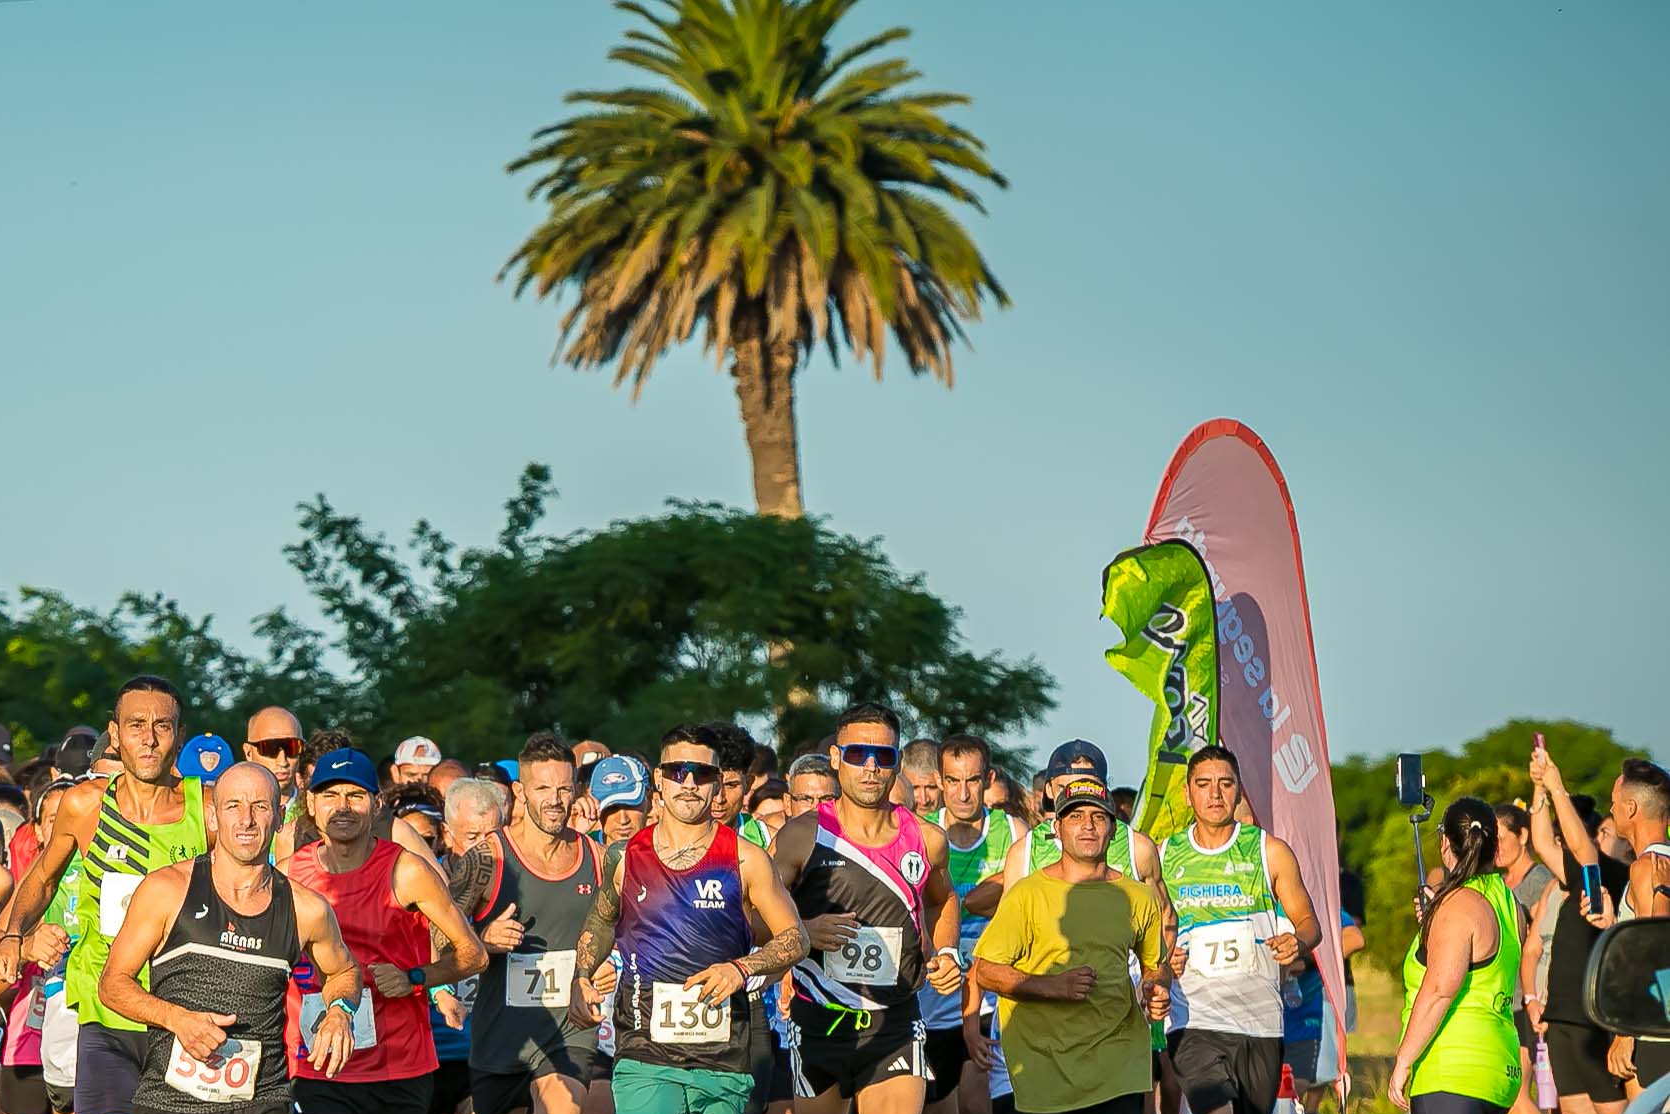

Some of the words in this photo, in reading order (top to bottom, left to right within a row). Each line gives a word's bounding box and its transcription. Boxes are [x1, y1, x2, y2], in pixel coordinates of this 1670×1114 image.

[694, 879, 724, 900] VR
[1178, 884, 1243, 898] FIGHIERA
[692, 900, 726, 909] TEAM
[220, 931, 263, 950] ATENAS
[1204, 939, 1241, 966] 75
[841, 942, 883, 972] 98
[524, 967, 561, 994] 71
[659, 1000, 725, 1029] 130
